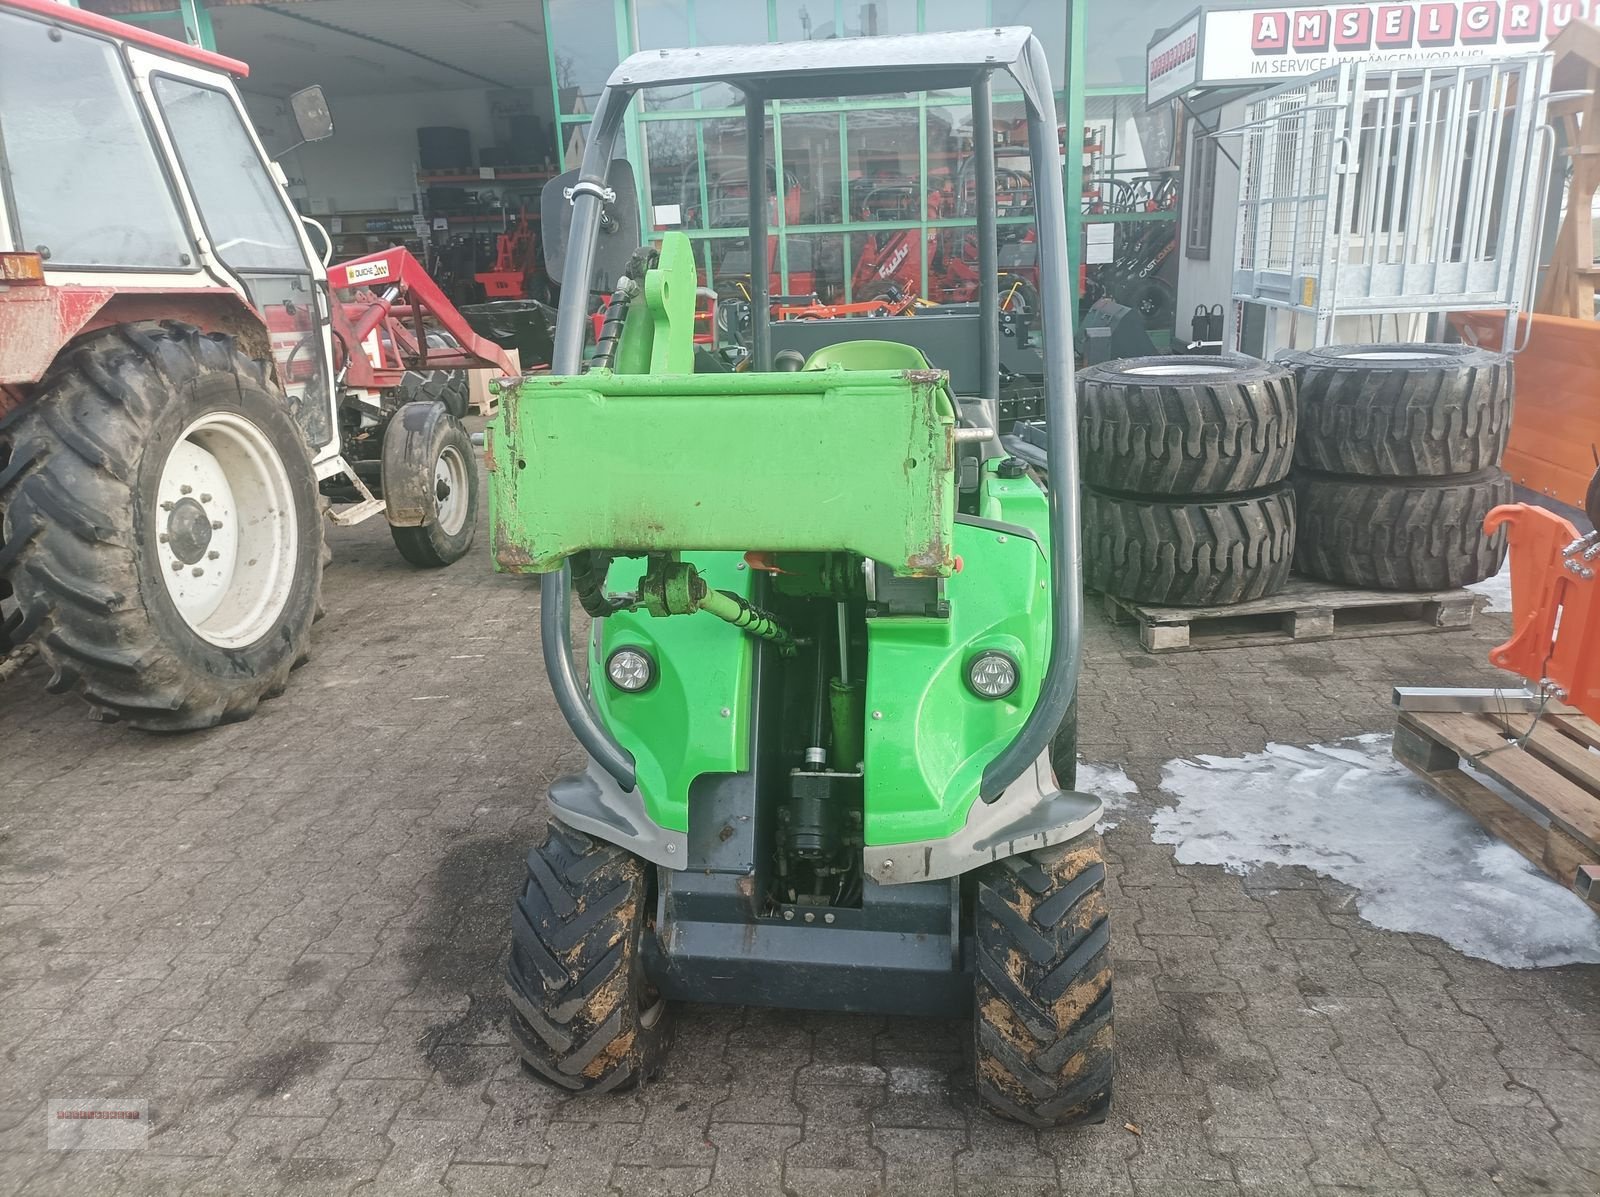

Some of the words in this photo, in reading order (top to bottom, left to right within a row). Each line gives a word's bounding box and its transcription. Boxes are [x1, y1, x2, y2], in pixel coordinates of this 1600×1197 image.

[1254, 2, 1600, 42] AMSELGRU
[1251, 61, 1267, 74] IM
[1271, 57, 1327, 73] SERVICE
[879, 243, 909, 279] Fuchs
